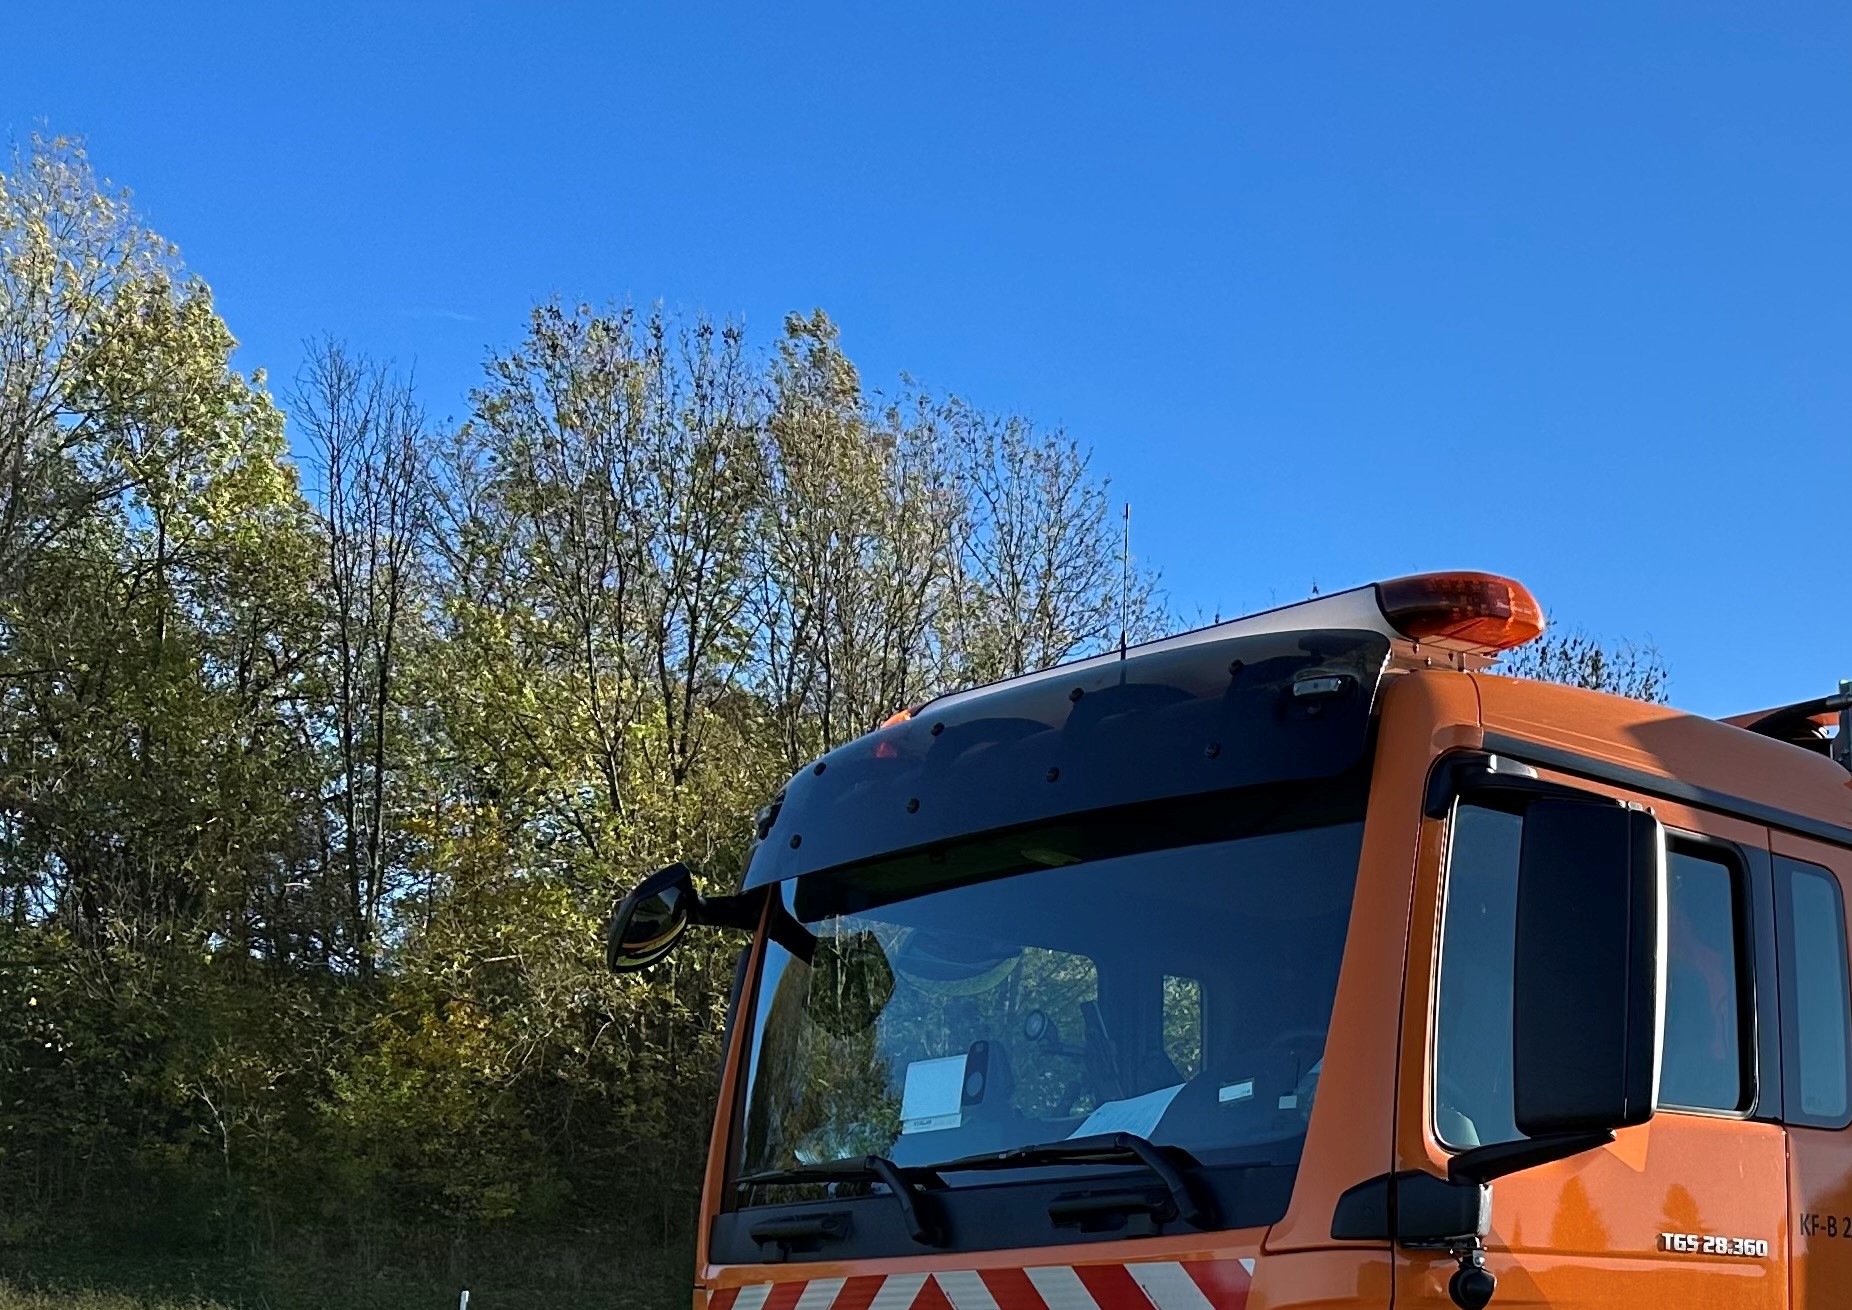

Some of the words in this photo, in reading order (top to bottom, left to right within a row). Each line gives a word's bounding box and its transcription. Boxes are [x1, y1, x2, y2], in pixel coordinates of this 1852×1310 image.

[1800, 1213, 1838, 1238] KF-B
[1662, 1231, 1699, 1253] TGS
[1701, 1234, 1769, 1258] 28.360
